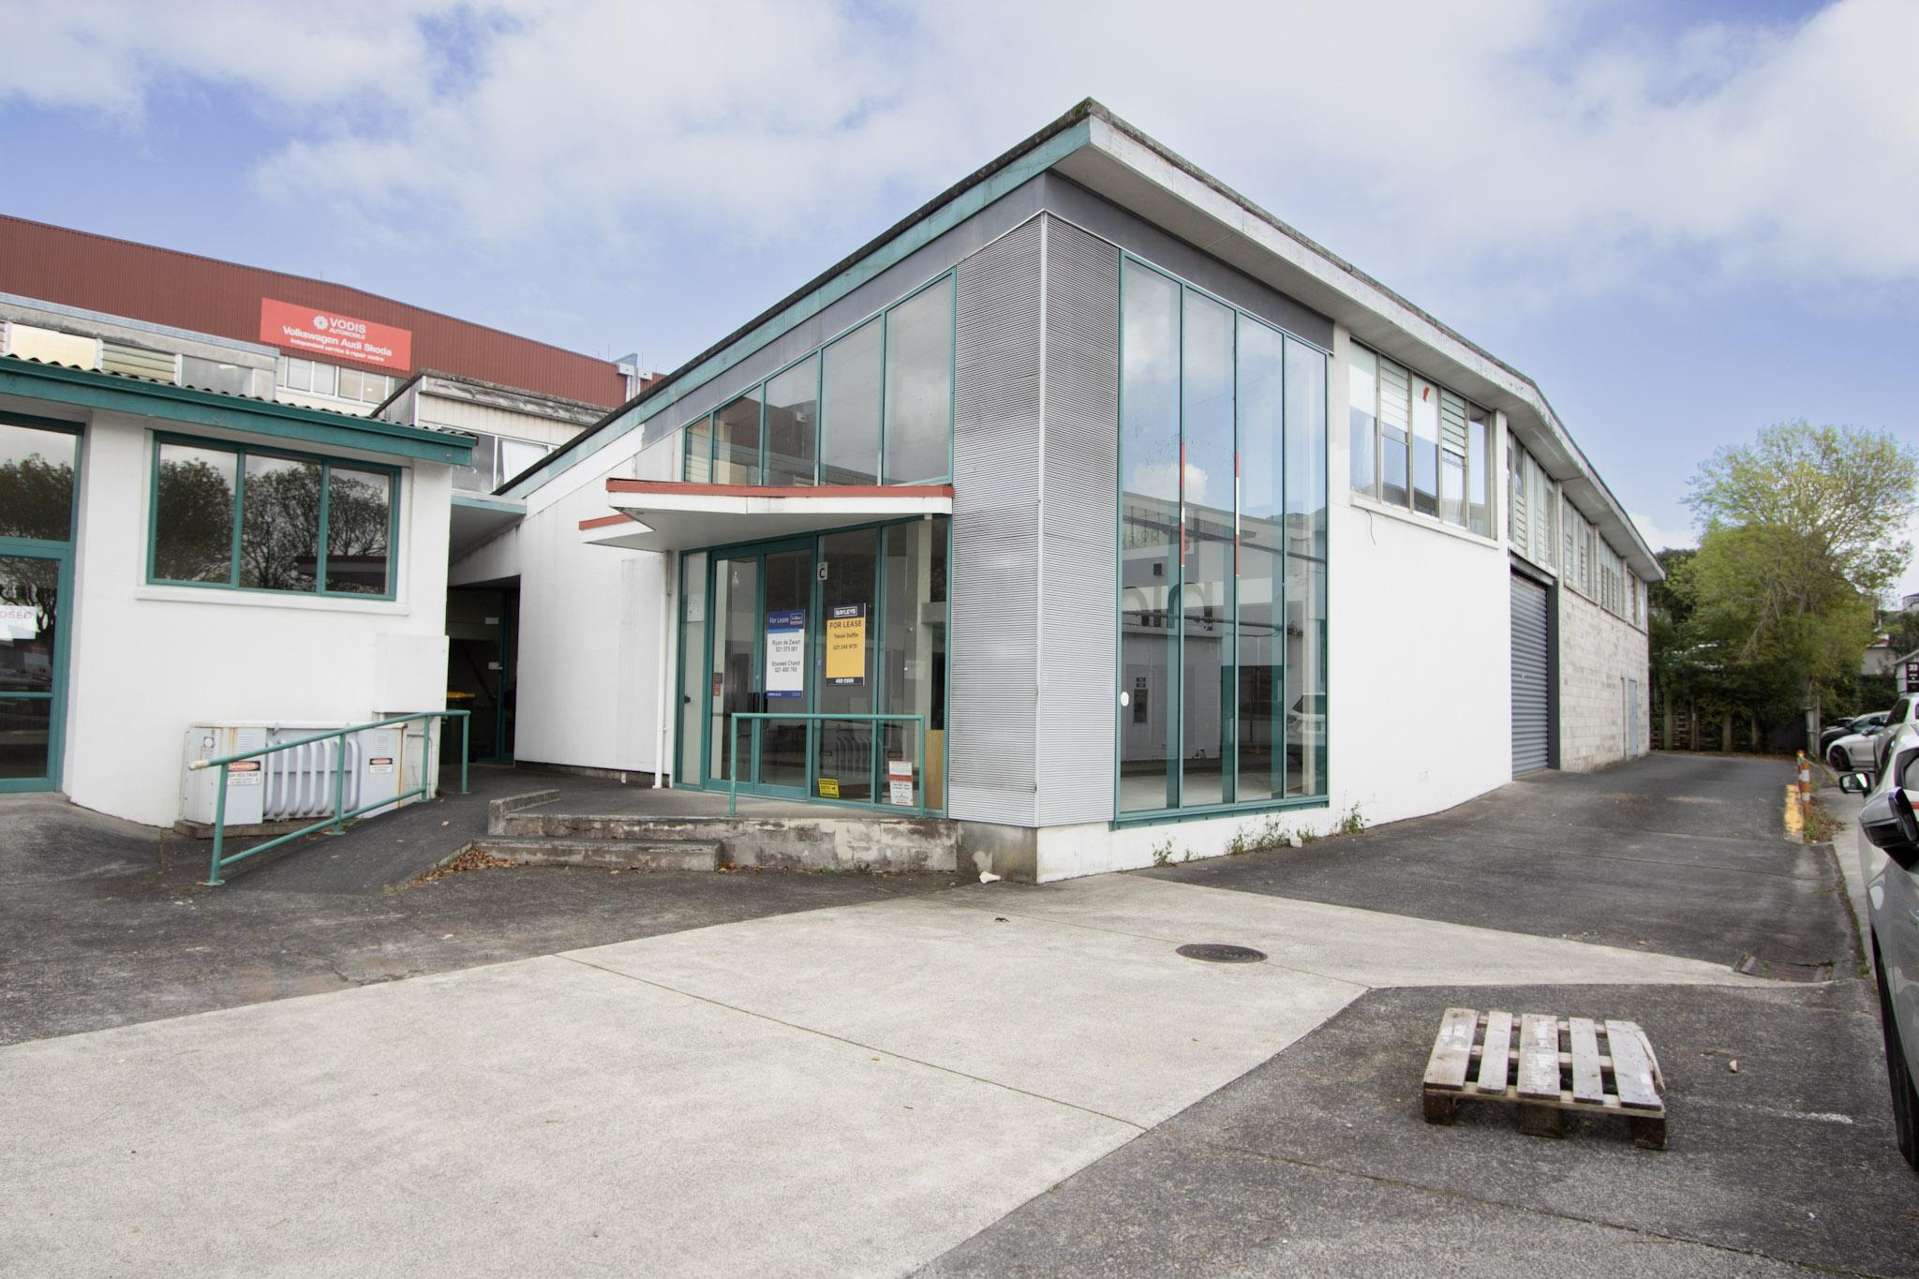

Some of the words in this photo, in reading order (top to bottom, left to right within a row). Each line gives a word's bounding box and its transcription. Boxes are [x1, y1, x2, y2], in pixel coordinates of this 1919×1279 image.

[329, 317, 366, 334] VODIS
[282, 325, 340, 345] Volkswagen
[340, 337, 363, 350] Audi
[364, 343, 393, 357] Skoda
[829, 621, 842, 629] FOR
[843, 620, 862, 628] LEASE
